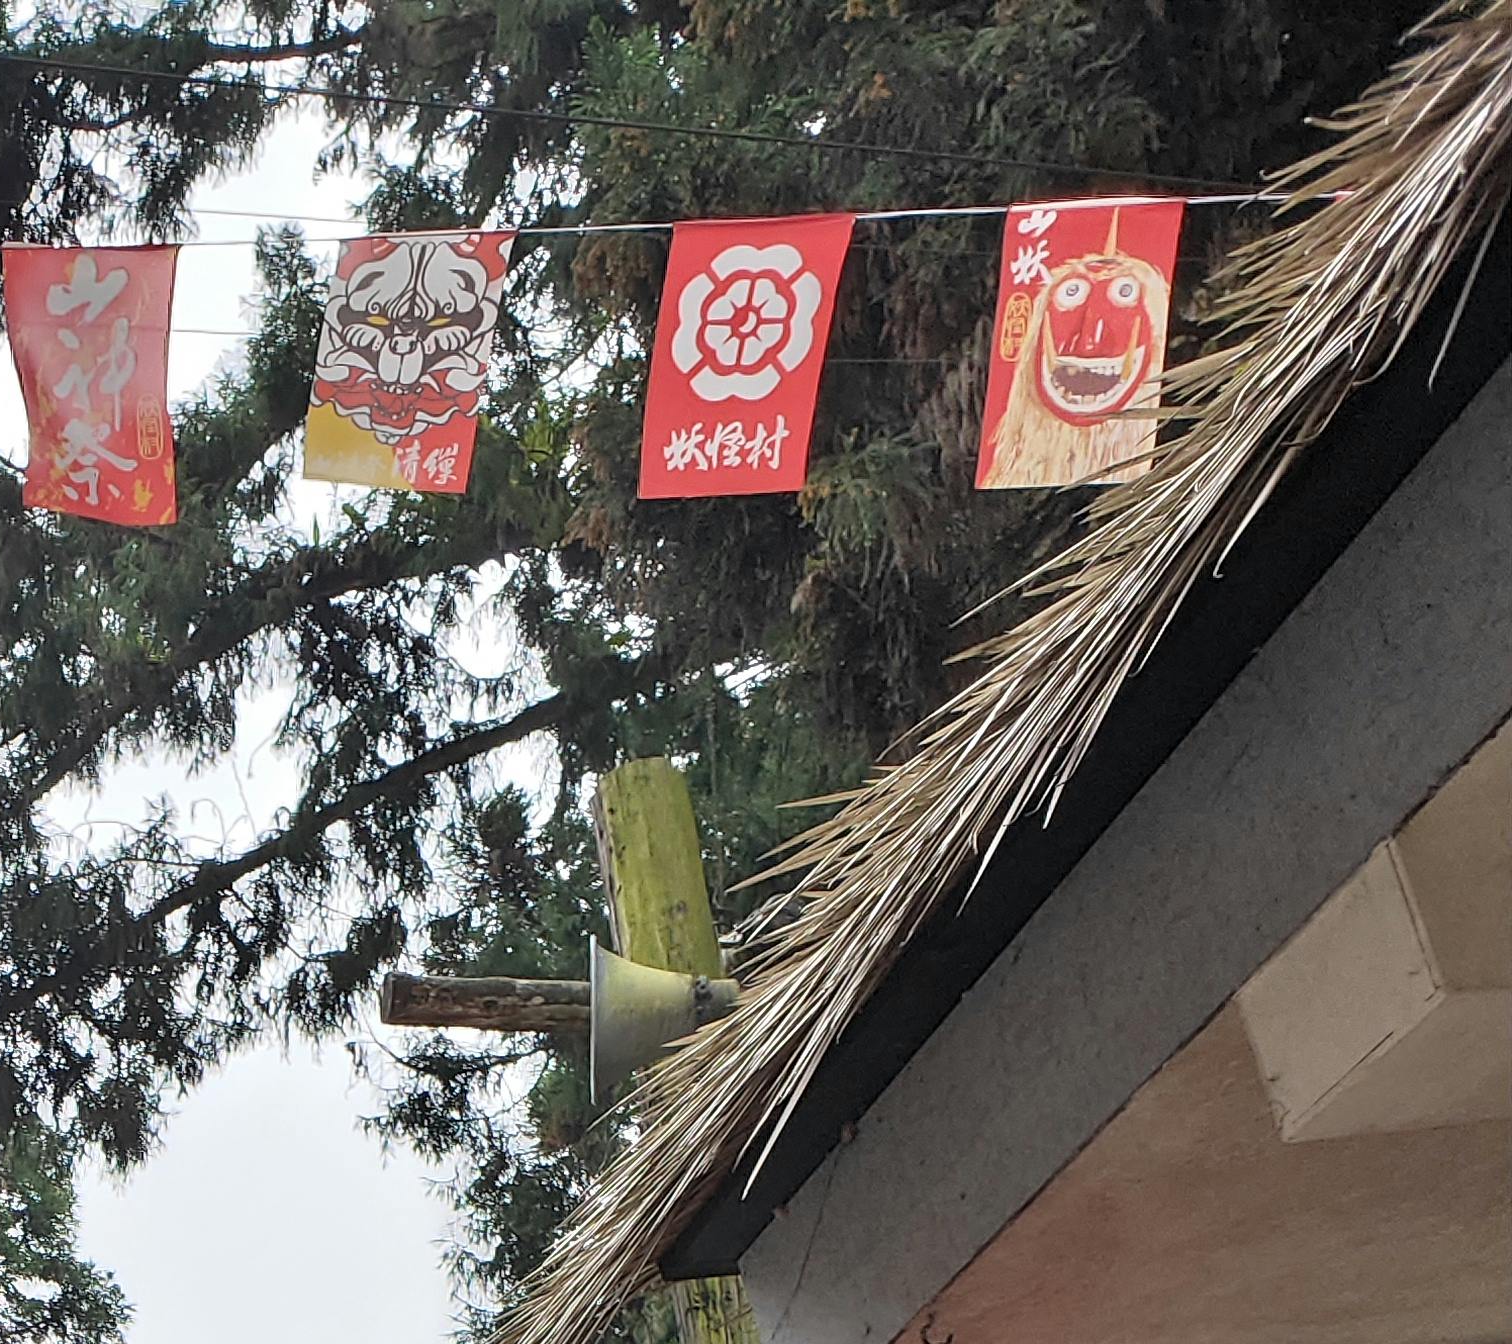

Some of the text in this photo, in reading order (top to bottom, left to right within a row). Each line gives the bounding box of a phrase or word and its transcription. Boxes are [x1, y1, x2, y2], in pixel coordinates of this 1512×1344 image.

[46, 253, 138, 506] 山神祭
[663, 414, 790, 471] 妖怪村
